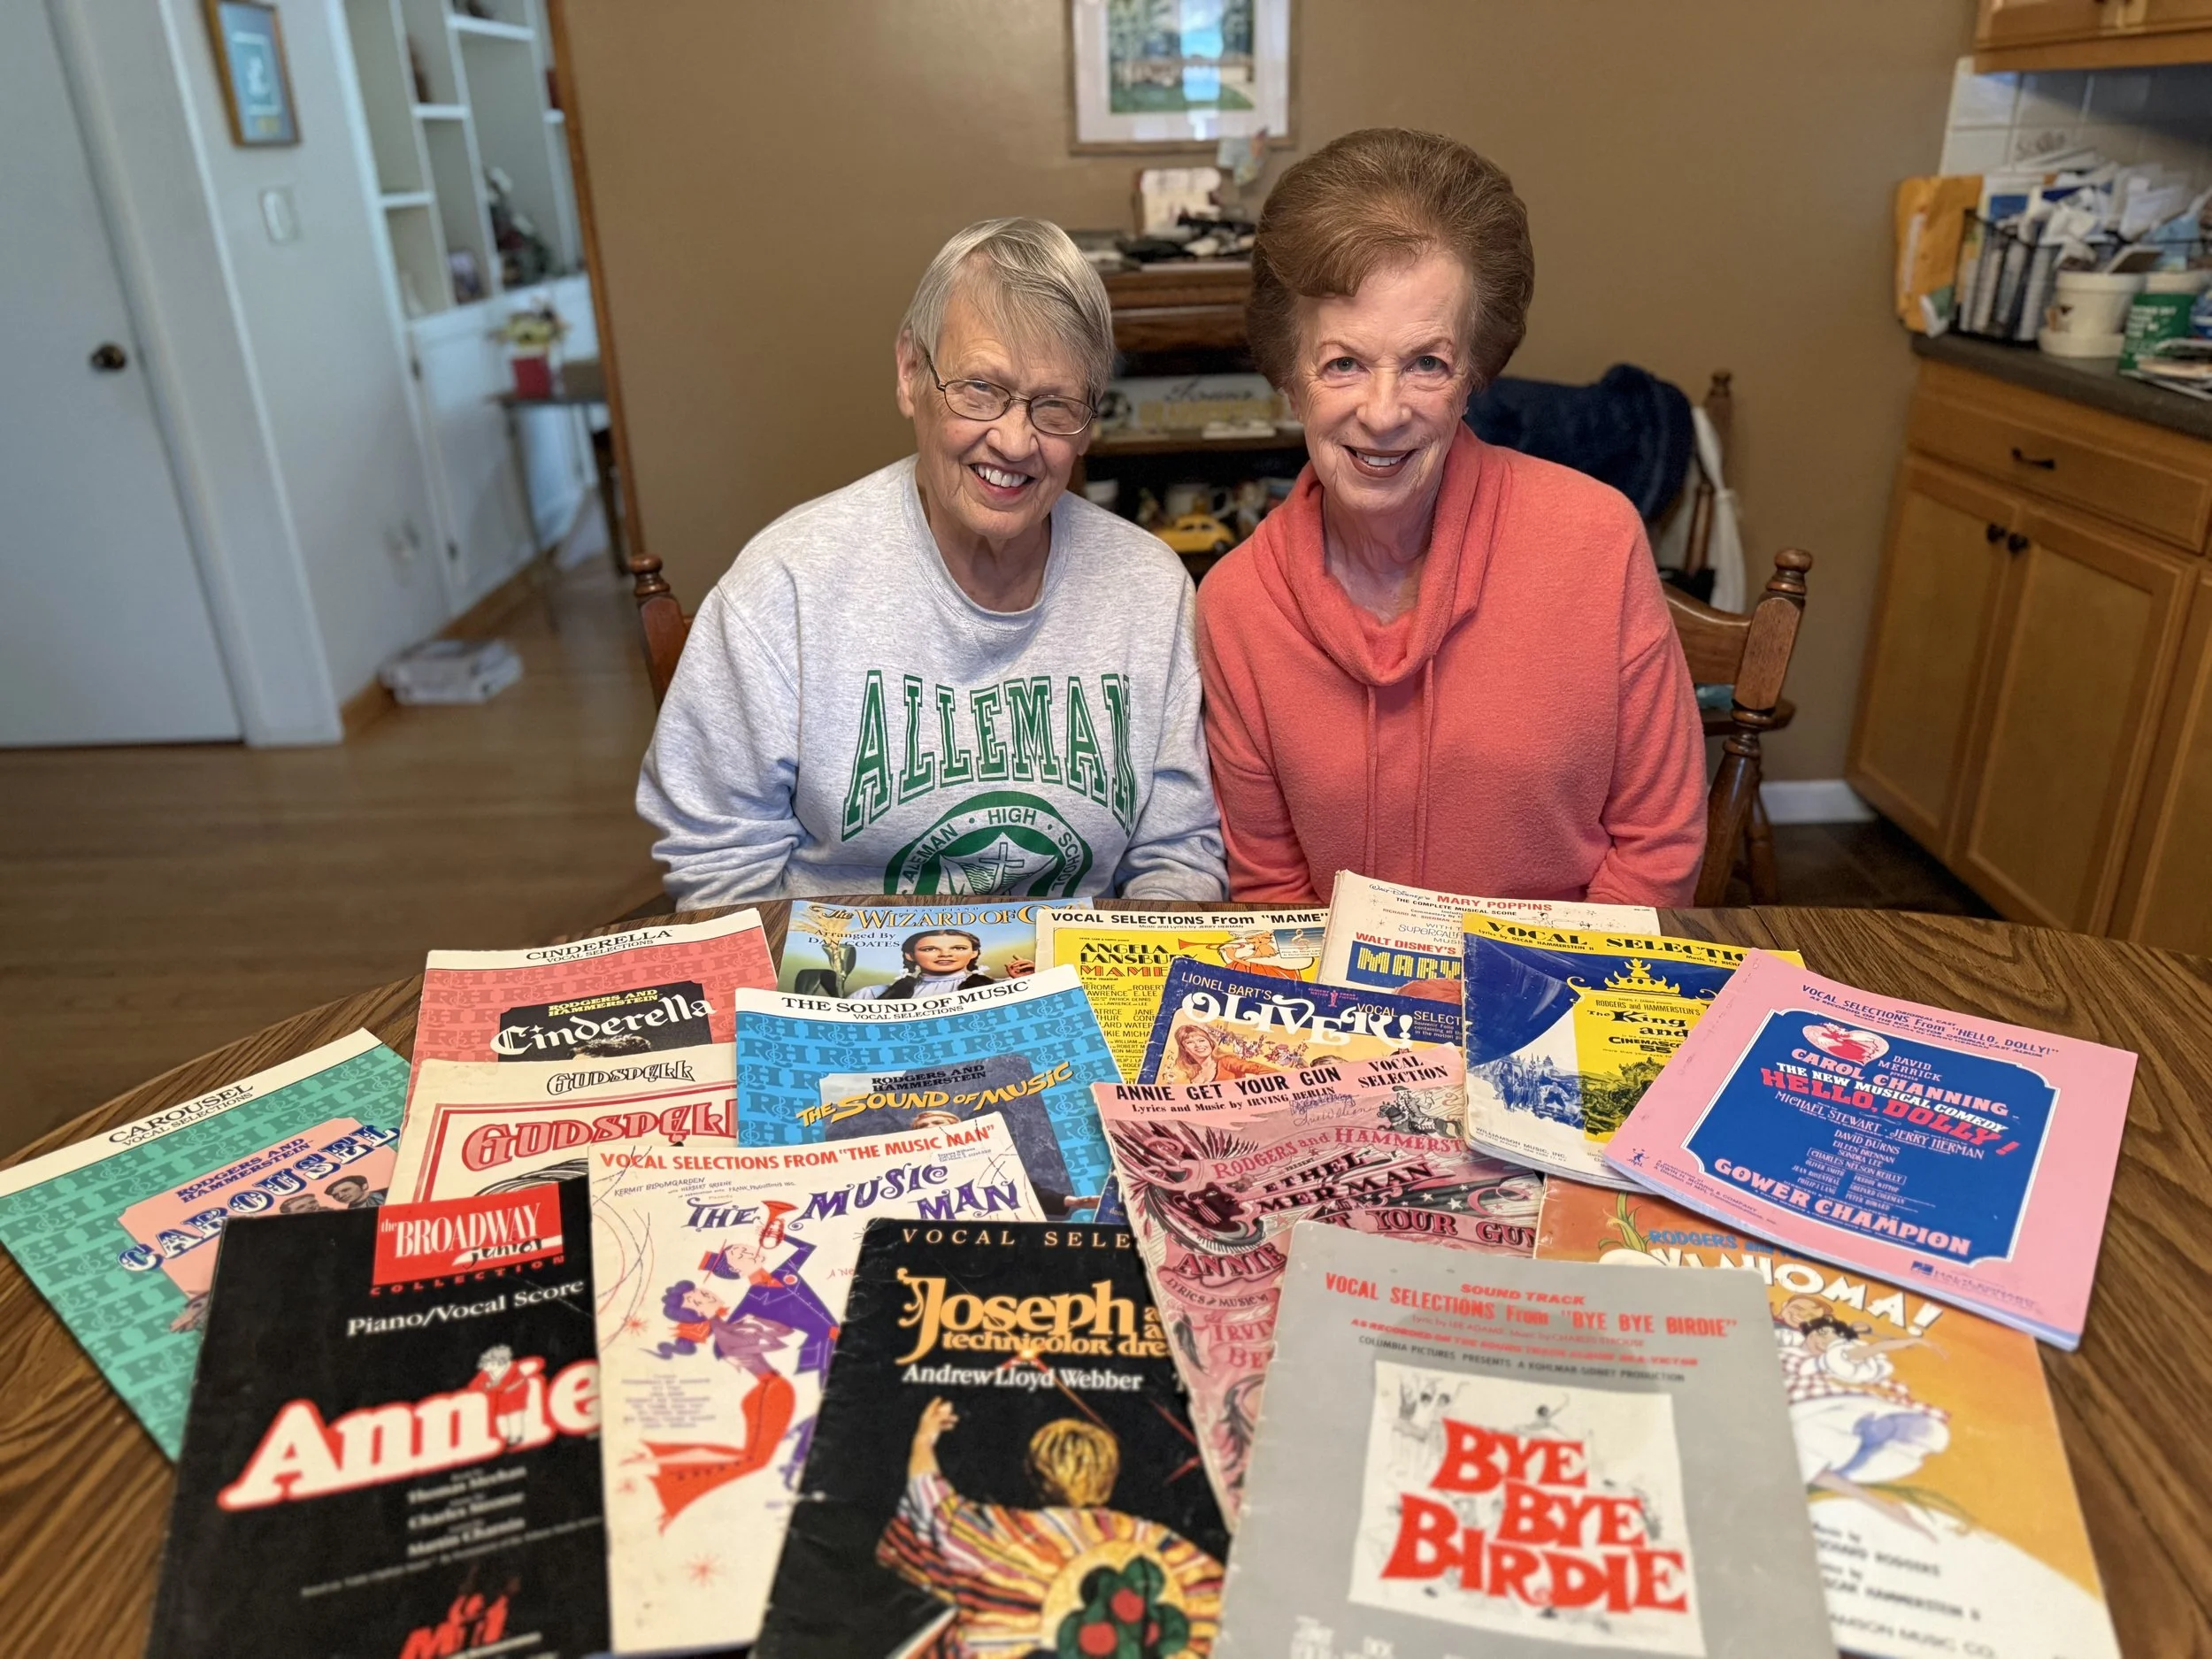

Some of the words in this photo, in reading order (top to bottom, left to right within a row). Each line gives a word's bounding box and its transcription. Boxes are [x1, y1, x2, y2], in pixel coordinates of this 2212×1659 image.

[841, 669, 1139, 841] ALLEMAN
[988, 808, 1037, 826] HIGH
[809, 904, 855, 920] The
[855, 910, 979, 929] WIZARD
[979, 911, 1016, 924] OF
[1051, 912, 1103, 922] VOCAL
[1111, 914, 1204, 925] SELECTIONS
[1211, 915, 1254, 925] From
[1262, 913, 1328, 923] "MAME"
[1413, 900, 1453, 910] COMPLETE
[1437, 895, 1481, 907] MARY
[1487, 902, 1553, 911] POPPINS
[526, 929, 672, 961] CINDERELLA
[807, 937, 841, 946] DAN
[814, 929, 875, 939] Arranged
[1080, 943, 1169, 954] ANGELA
[1356, 932, 1391, 946] WALT
[1394, 940, 1456, 955] DISNEY'S
[1486, 921, 1588, 946] VOCAL
[1537, 941, 1586, 950] HAMMERSTEIN
[547, 951, 584, 964] VOCAL
[586, 940, 654, 957] SELECTIONS
[1357, 947, 1461, 979] MARY
[1080, 965, 1169, 977] MAME
[1181, 972, 1225, 992] LIONEL
[1228, 983, 1271, 1001] BART'S
[548, 994, 621, 1011] RODGERS
[624, 989, 658, 998] AND
[548, 995, 658, 1017] HAMMERSTEIN
[780, 996, 832, 1012] THE
[834, 1000, 918, 1014] SOUND
[923, 996, 951, 1010] OF
[957, 980, 1029, 1004] MUSIC
[894, 1006, 964, 1019] SELECTIONS
[1356, 1002, 1398, 1017] VOCAL
[1595, 1000, 1626, 1009] RODGERS
[1644, 1004, 1701, 1016] HAMMERSTEIN'S
[1801, 985, 1837, 1003] VOCAL
[1843, 1000, 1909, 1023] SELECTIONS
[1915, 1018, 1945, 1033] From
[490, 994, 717, 1055] Cinderella
[1181, 991, 1414, 1051] OLIVER!
[1610, 1010, 1686, 1027] King
[1369, 1055, 1425, 1073] VOCAL
[1640, 1045, 1671, 1054] 55
[1892, 1055, 1932, 1071] DAVID
[547, 1060, 695, 1095] GODSPELL
[871, 1069, 949, 1086] RODGERS
[951, 1064, 986, 1075] AND
[872, 1071, 987, 1092] HAMMERSTEIN
[1116, 1083, 1176, 1102] ANNIE
[1187, 1084, 1223, 1102] GET
[1238, 1075, 1288, 1096] YOUR
[1300, 1067, 1342, 1084] GUN
[1358, 1064, 1448, 1089] SELECTION
[1791, 1048, 1865, 1080] CAROL
[1872, 1073, 2008, 1118] CHANNING
[1878, 1060, 1942, 1082] MERRICK
[109, 1083, 254, 1145] CAROUSEL
[796, 1102, 838, 1127] THE
[831, 1090, 952, 1124] SOUND
[953, 1093, 979, 1105] OF
[1132, 1102, 1167, 1114] Lyrics
[1171, 1104, 1192, 1113] and
[1194, 1102, 1227, 1112] Music
[1229, 1101, 1244, 1110] by
[1247, 1093, 1289, 1108] IRVING
[1292, 1087, 1336, 1102] BERLIN
[1761, 1067, 1878, 1114] HELLO,
[1884, 1103, 2019, 1156] DOLLY!
[1776, 1062, 1808, 1077] THE
[1812, 1071, 1849, 1087] NEW
[1854, 1080, 1932, 1110] MUSICAL
[1933, 1103, 2008, 1134] COMEDY
[122, 1125, 170, 1147] VOCAL
[171, 1092, 254, 1127] SELECTIONS
[1774, 1090, 1825, 1117] MICHAEL
[1827, 1109, 1882, 1134] STEWART
[1890, 1125, 1931, 1146] JERRY
[1931, 1139, 1985, 1160] HERMAN
[1476, 1126, 1520, 1146] WILLIAMSON
[1834, 1129, 1863, 1144] DAVID
[1865, 1139, 1901, 1155] BURNS
[175, 1156, 263, 1198] RODGERS
[266, 1139, 304, 1156] AND
[600, 1153, 671, 1170] VOCAL
[672, 1156, 780, 1171] SELECTIONS
[784, 1150, 839, 1168] FROM
[839, 1144, 879, 1161] "THE
[884, 1136, 942, 1157] MUSIC
[1214, 1141, 1297, 1179] RODGERS
[1299, 1133, 1330, 1149] and
[180, 1141, 311, 1203] HAMMERSTEIN
[1256, 1162, 1437, 1214] MERMAN
[1263, 1151, 1371, 1193] ETHEL
[117, 1125, 400, 1271] CAROUSEL
[614, 1186, 643, 1197] KERMIT
[787, 1163, 948, 1231] MUSIC
[907, 1179, 1022, 1220] MAN
[1714, 1157, 1809, 1209] GOWER
[1813, 1200, 1971, 1256] CHAMPION
[681, 1197, 761, 1232] THE
[1366, 1209, 1459, 1236] YOUR
[380, 1218, 398, 1233] the
[395, 1202, 541, 1260] BROADWAY
[902, 1228, 1017, 1248] VOCAL
[1648, 1229, 1738, 1250] RODGERS
[462, 1237, 544, 1270] junior
[1173, 1242, 1287, 1278] ANNIE
[368, 1255, 566, 1296] COLLECTION
[346, 1292, 507, 1339] Piano/Vocal
[512, 1278, 586, 1310] Score
[1165, 1278, 1205, 1303] LYRICS
[1218, 1296, 1257, 1308] MUSIC
[1325, 1271, 1379, 1301] VOCAL
[1390, 1286, 1496, 1320] SELECTIONS
[1506, 1304, 1549, 1325] From
[1618, 1313, 1654, 1333] BYE
[1461, 1283, 1522, 1301] SOUND
[1524, 1292, 1586, 1305] TRACK
[895, 1267, 1135, 1365] Joseph
[941, 1333, 1113, 1357] technicolor
[1358, 1335, 1408, 1352] COLUMBIA
[1410, 1345, 1455, 1361] PICTURES
[1463, 1353, 1511, 1368] PRESENTS
[902, 1365, 994, 1386] Andrew
[994, 1366, 1056, 1393] Lloyd
[1060, 1368, 1144, 1392] Webber
[216, 1355, 604, 1511] Annie
[1429, 1416, 1587, 1494] BYE
[1494, 1475, 1646, 1548] BYE
[1379, 1492, 1688, 1614] BIRDIE
